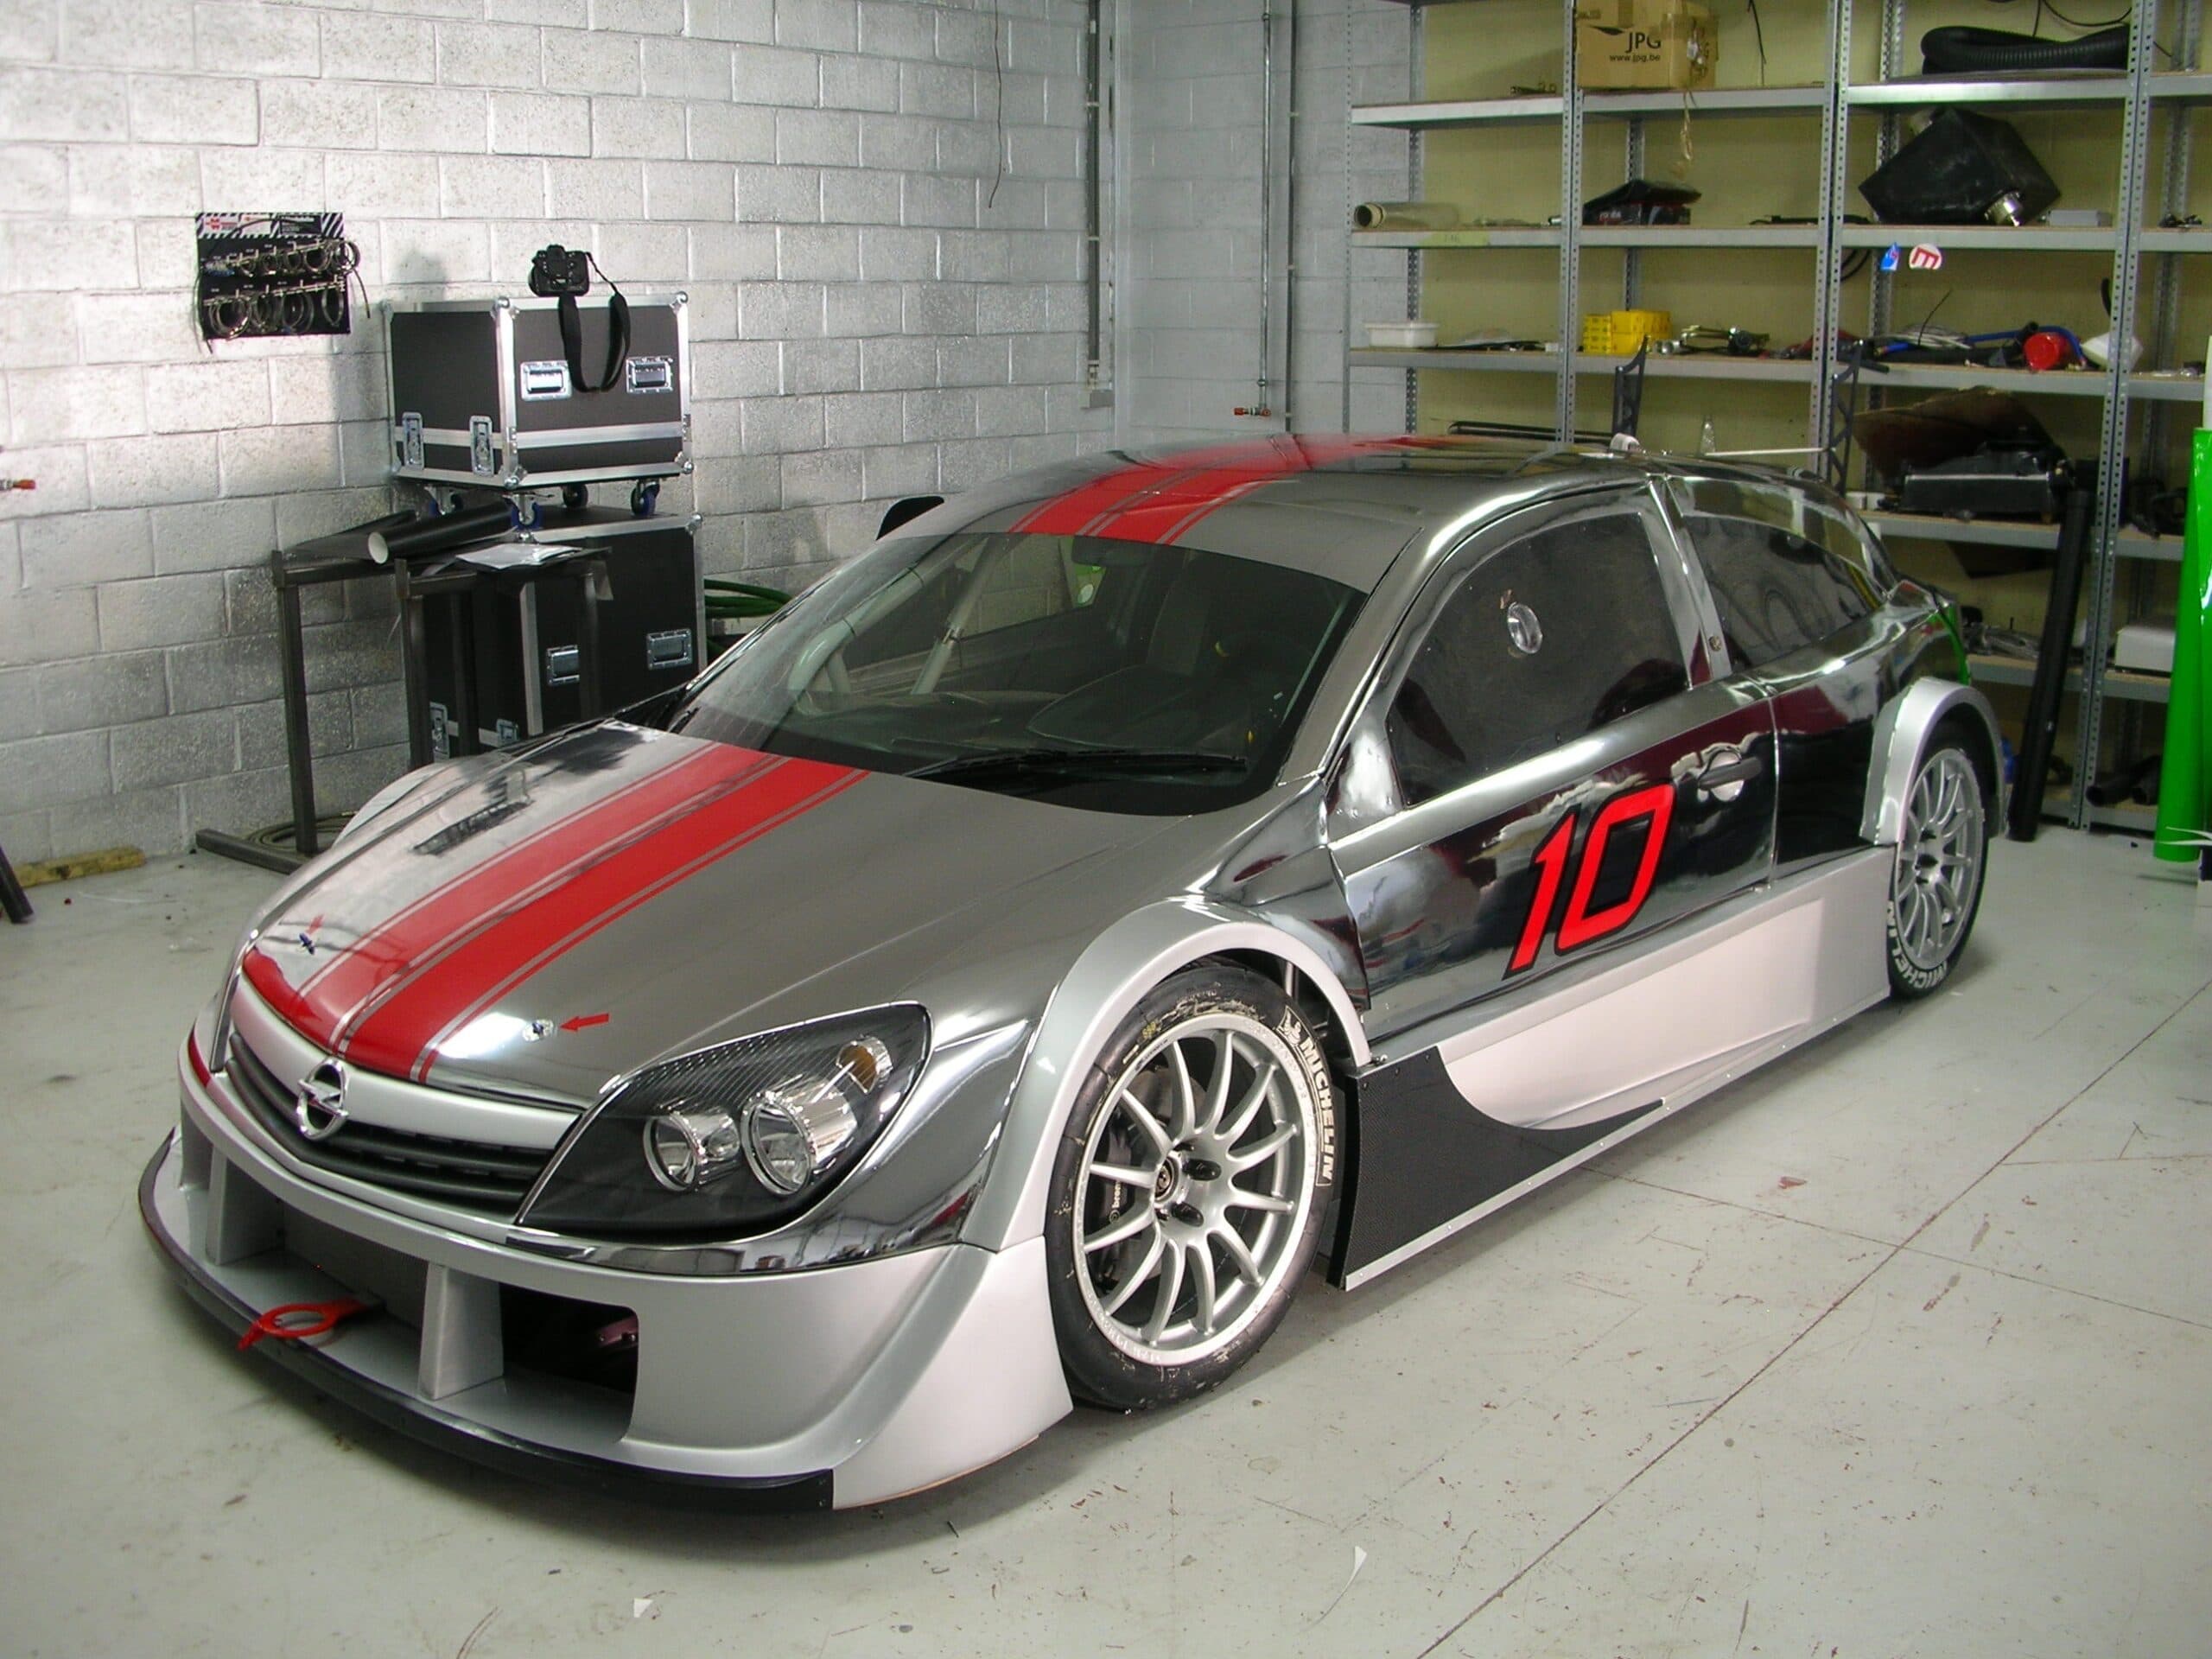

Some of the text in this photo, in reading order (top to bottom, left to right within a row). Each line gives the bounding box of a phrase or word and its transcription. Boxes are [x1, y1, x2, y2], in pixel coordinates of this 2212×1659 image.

[1610, 54, 1660, 63] www.jpg.be
[1625, 32, 1661, 53] JPG
[1504, 781, 1675, 978] 10
[1299, 1036, 1335, 1182] MICHELIN
